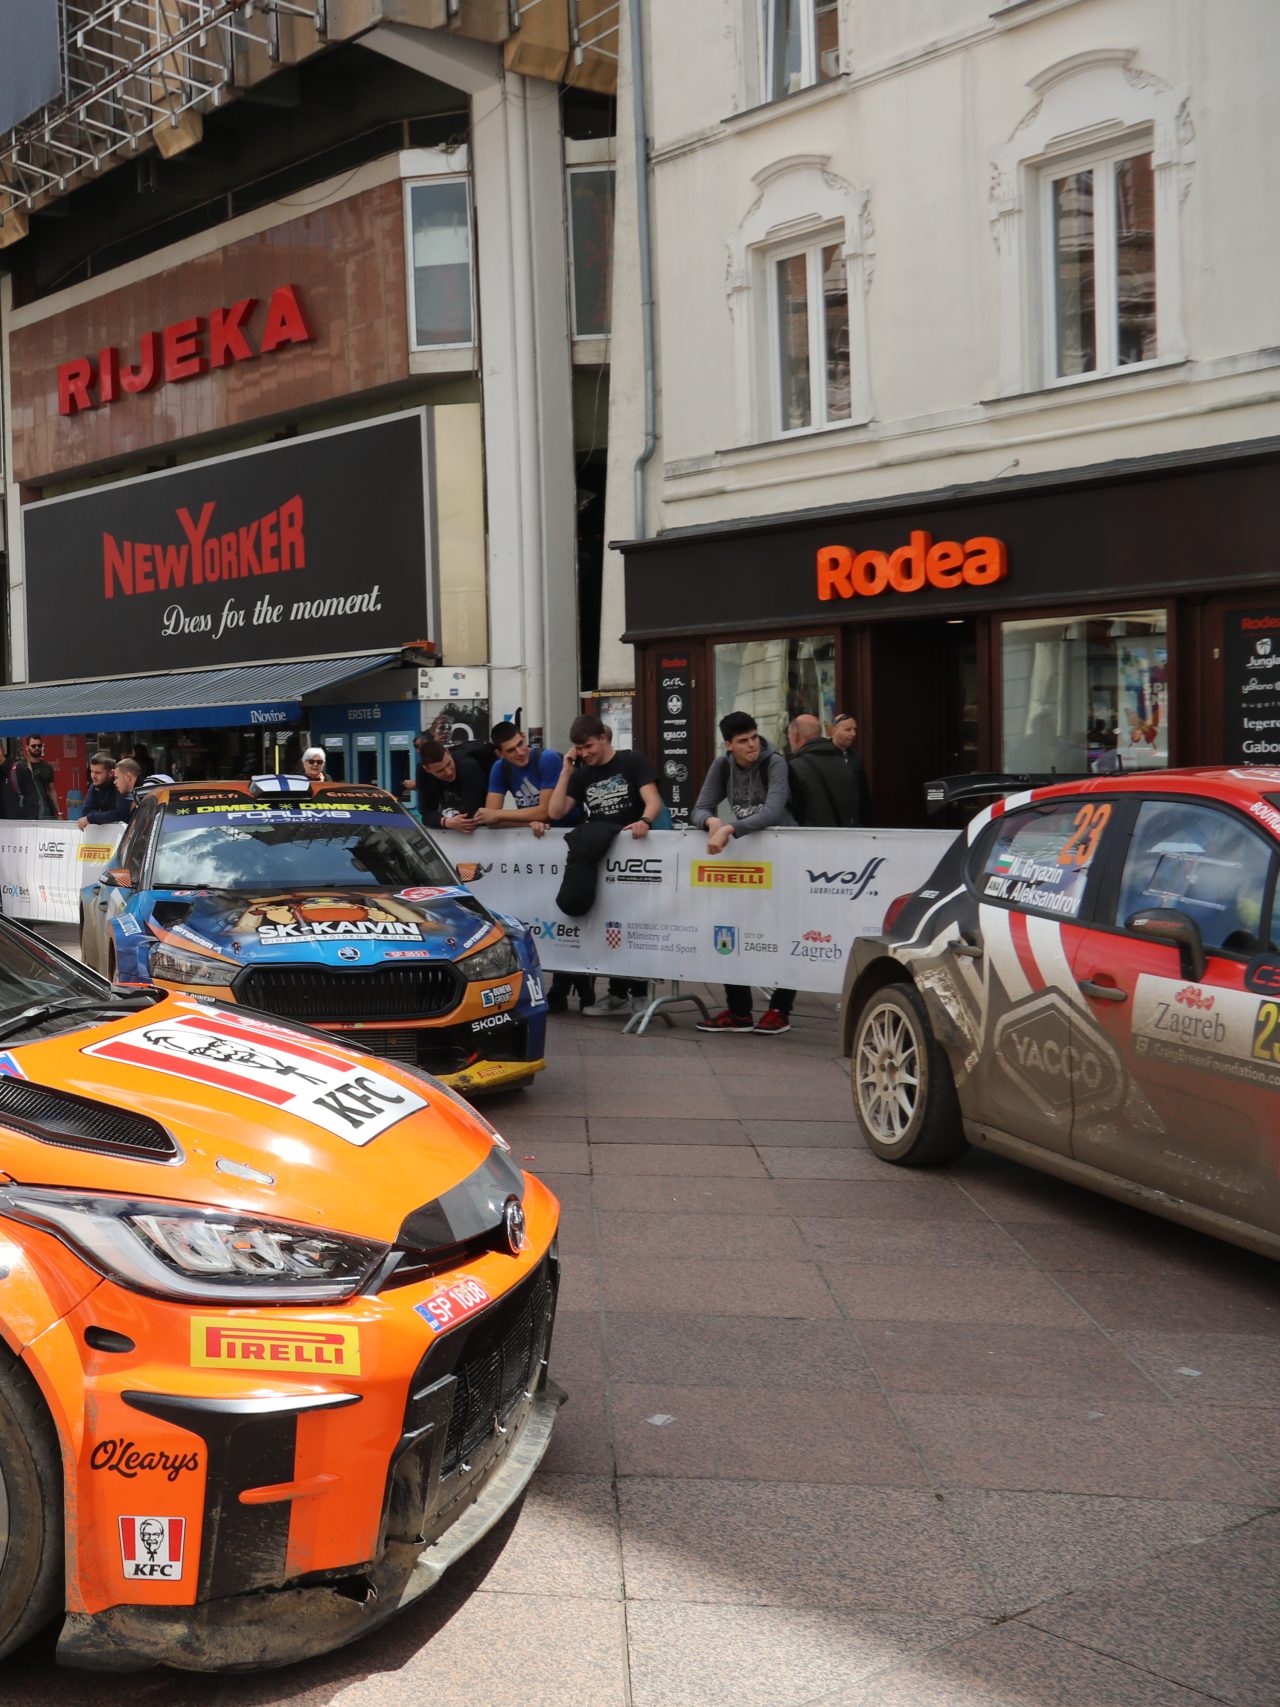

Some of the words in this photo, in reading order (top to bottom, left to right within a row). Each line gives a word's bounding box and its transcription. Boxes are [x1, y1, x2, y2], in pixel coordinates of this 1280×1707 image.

[56, 284, 314, 416] RIJEKA
[817, 530, 1007, 600] Rodea
[161, 603, 211, 636] Dress
[211, 598, 246, 640] for
[252, 595, 283, 627] the
[290, 584, 382, 622] moment.
[251, 710, 287, 724] iNovine
[348, 709, 372, 720] ERSTE
[197, 803, 271, 814] DIMEX
[227, 810, 351, 820] FORUM8
[299, 802, 373, 812] DIMEX
[1056, 803, 1113, 867] 23
[501, 863, 558, 875] CASTO
[606, 858, 662, 874] WRC
[697, 865, 765, 885] PIRELLI
[1022, 859, 1064, 884] Gryazin
[810, 887, 854, 896] LUBRICANTS
[998, 880, 1009, 899] K.
[1010, 881, 1080, 914] Aleksandrov
[257, 921, 421, 938] SK-KAMIN
[627, 922, 659, 931] REPUBLIC
[661, 923, 669, 931] OF
[671, 924, 699, 933] CROATIA
[627, 930, 660, 944] Ministry
[662, 932, 671, 942] of
[627, 941, 659, 951] Tourism
[660, 943, 675, 952] and
[676, 942, 697, 955] Sport
[744, 942, 778, 953] ZAGREB
[791, 940, 842, 961] Zagreb
[1155, 1001, 1226, 1043] Zagreb
[1254, 1002, 1280, 1061] 2
[1011, 1030, 1105, 1090] YACCO
[313, 1076, 406, 1130] KFC
[428, 1296, 454, 1323] SP
[206, 1326, 345, 1365] PIRELLI
[90, 1437, 199, 1482] O'Learys
[132, 1563, 174, 1578] KFC
